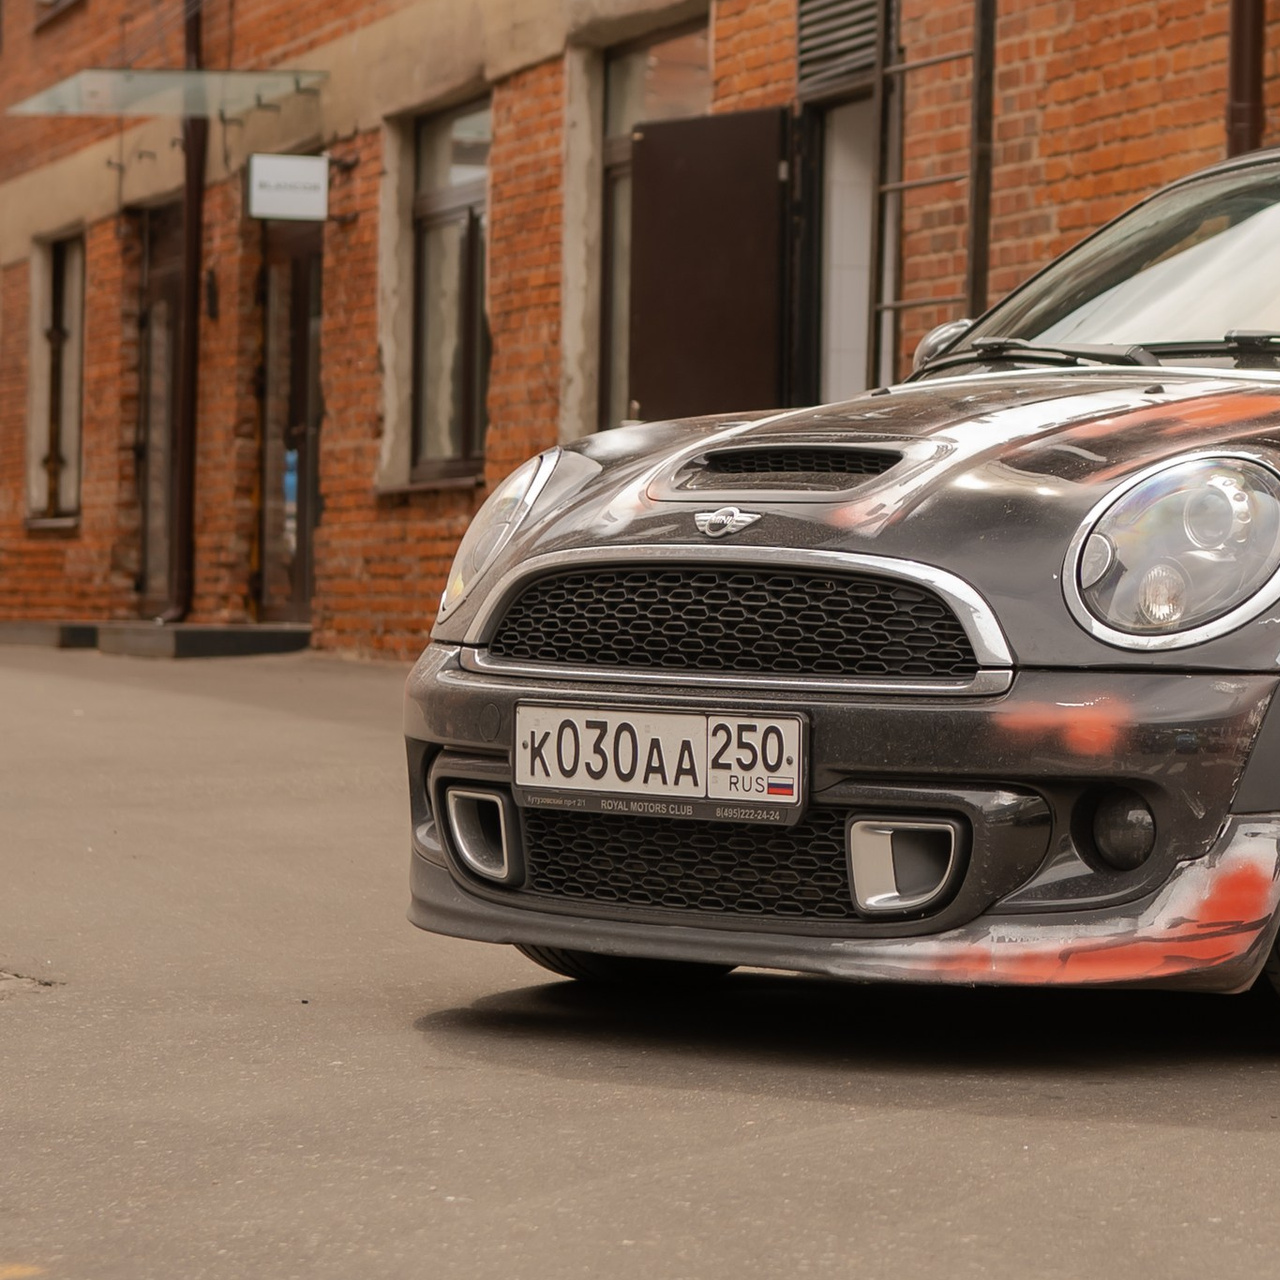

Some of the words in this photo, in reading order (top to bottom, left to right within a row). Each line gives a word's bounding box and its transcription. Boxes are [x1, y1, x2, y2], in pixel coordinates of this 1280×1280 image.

[711, 723, 784, 772] 250
[730, 775, 765, 793] RUS
[601, 799, 629, 811] ROYAL
[630, 802, 667, 814] MOTORS
[669, 804, 693, 816] CLUB
[716, 807, 780, 820] 8(495)222-24-24
